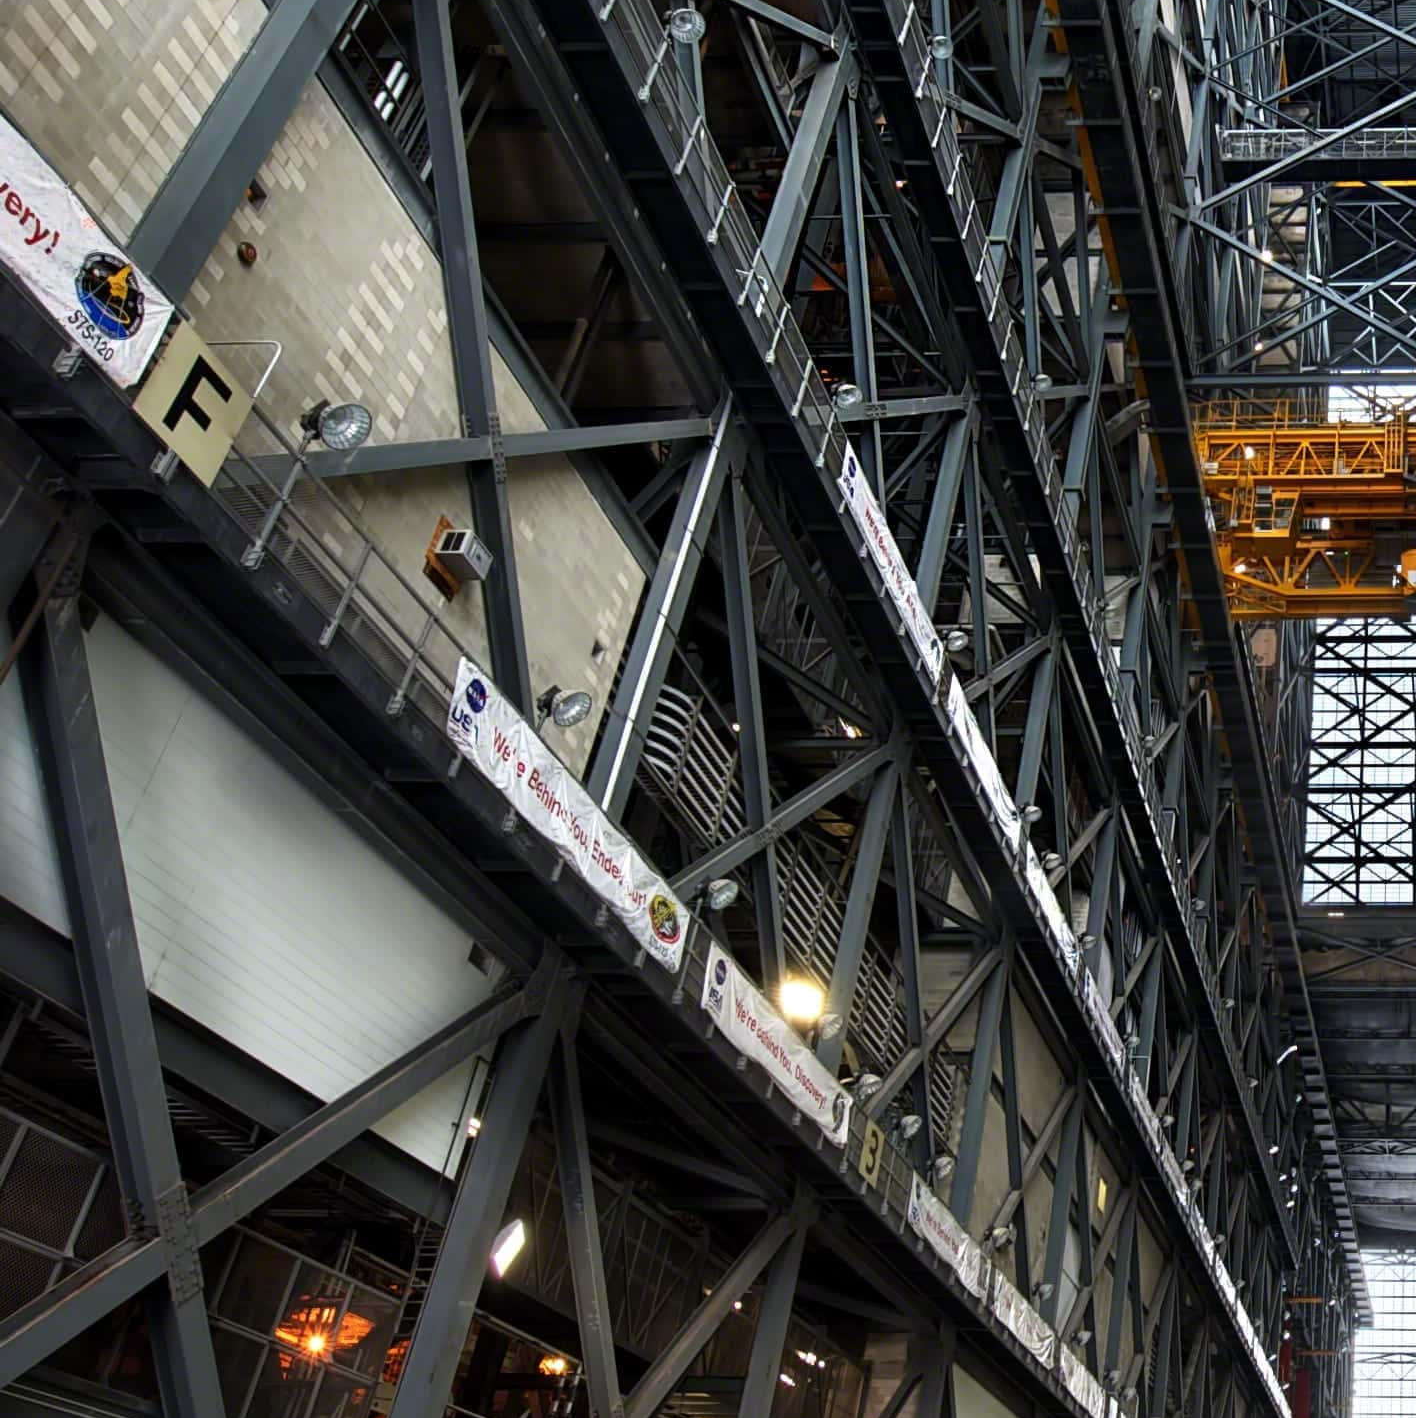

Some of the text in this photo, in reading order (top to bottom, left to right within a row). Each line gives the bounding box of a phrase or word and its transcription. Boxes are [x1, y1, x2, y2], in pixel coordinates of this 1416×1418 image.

[67, 309, 115, 362] STS-120
[162, 354, 233, 432] F
[865, 1129, 880, 1175] 3
